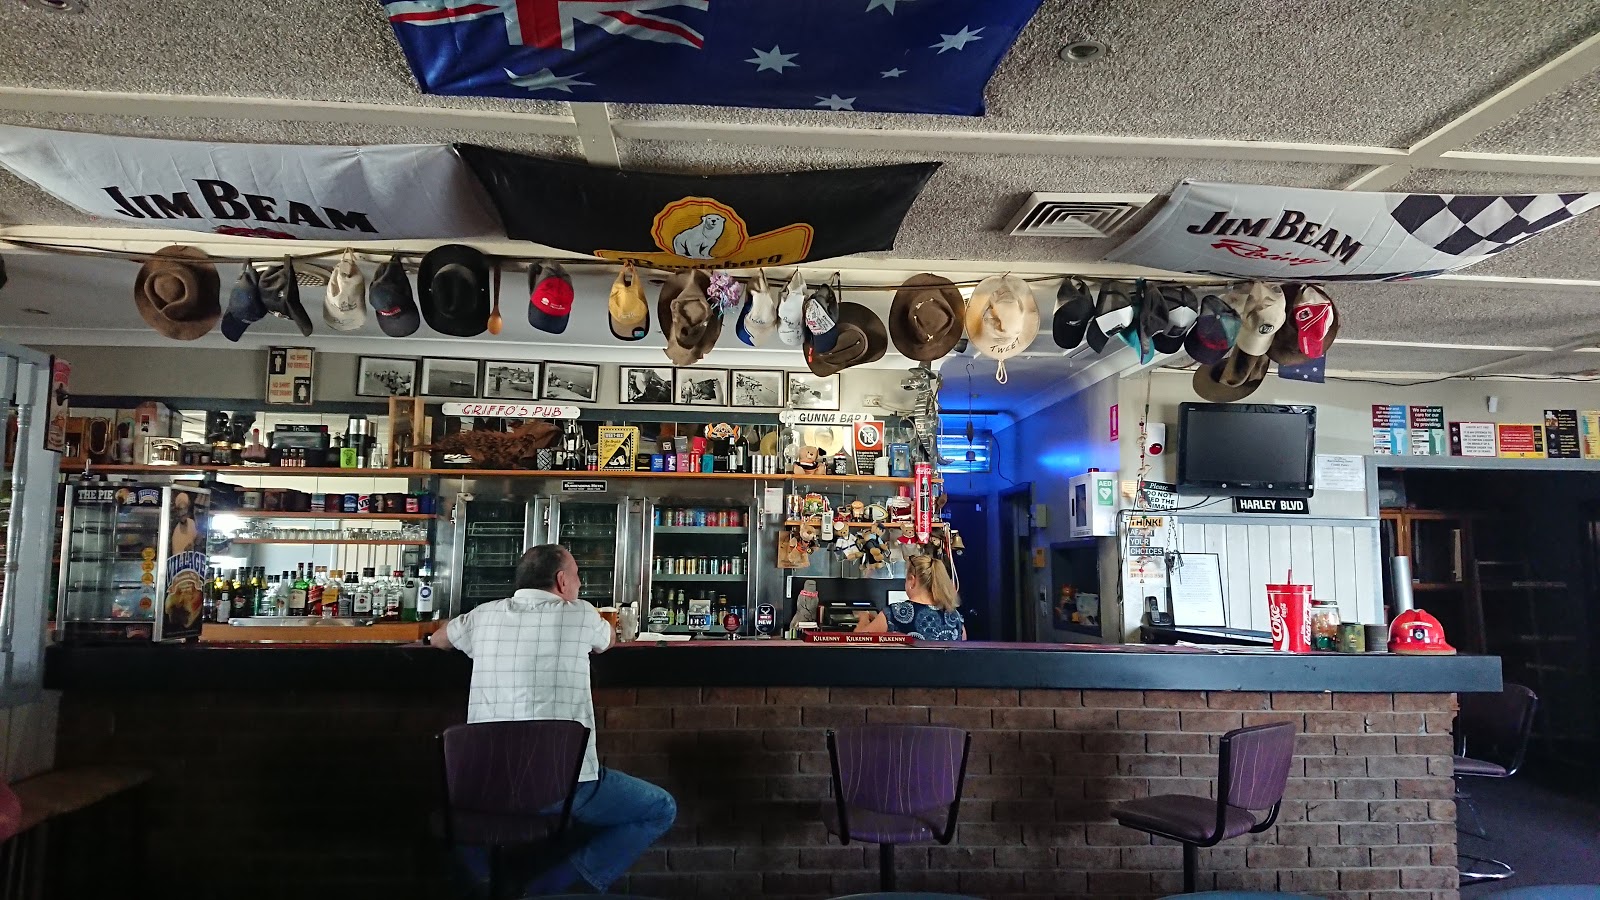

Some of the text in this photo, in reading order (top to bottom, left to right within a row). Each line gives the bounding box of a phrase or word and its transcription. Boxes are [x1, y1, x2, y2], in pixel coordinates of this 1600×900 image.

[101, 178, 380, 234] JIM BEAM
[1186, 209, 1364, 266] JIM BEAM
[532, 406, 562, 418] PUB
[799, 412, 836, 422] GUNNA
[1149, 482, 1168, 491] Please
[78, 490, 114, 500] THE PIE
[1240, 499, 1304, 511] HARLEY BLVD
[166, 550, 207, 585] VILLAGE
